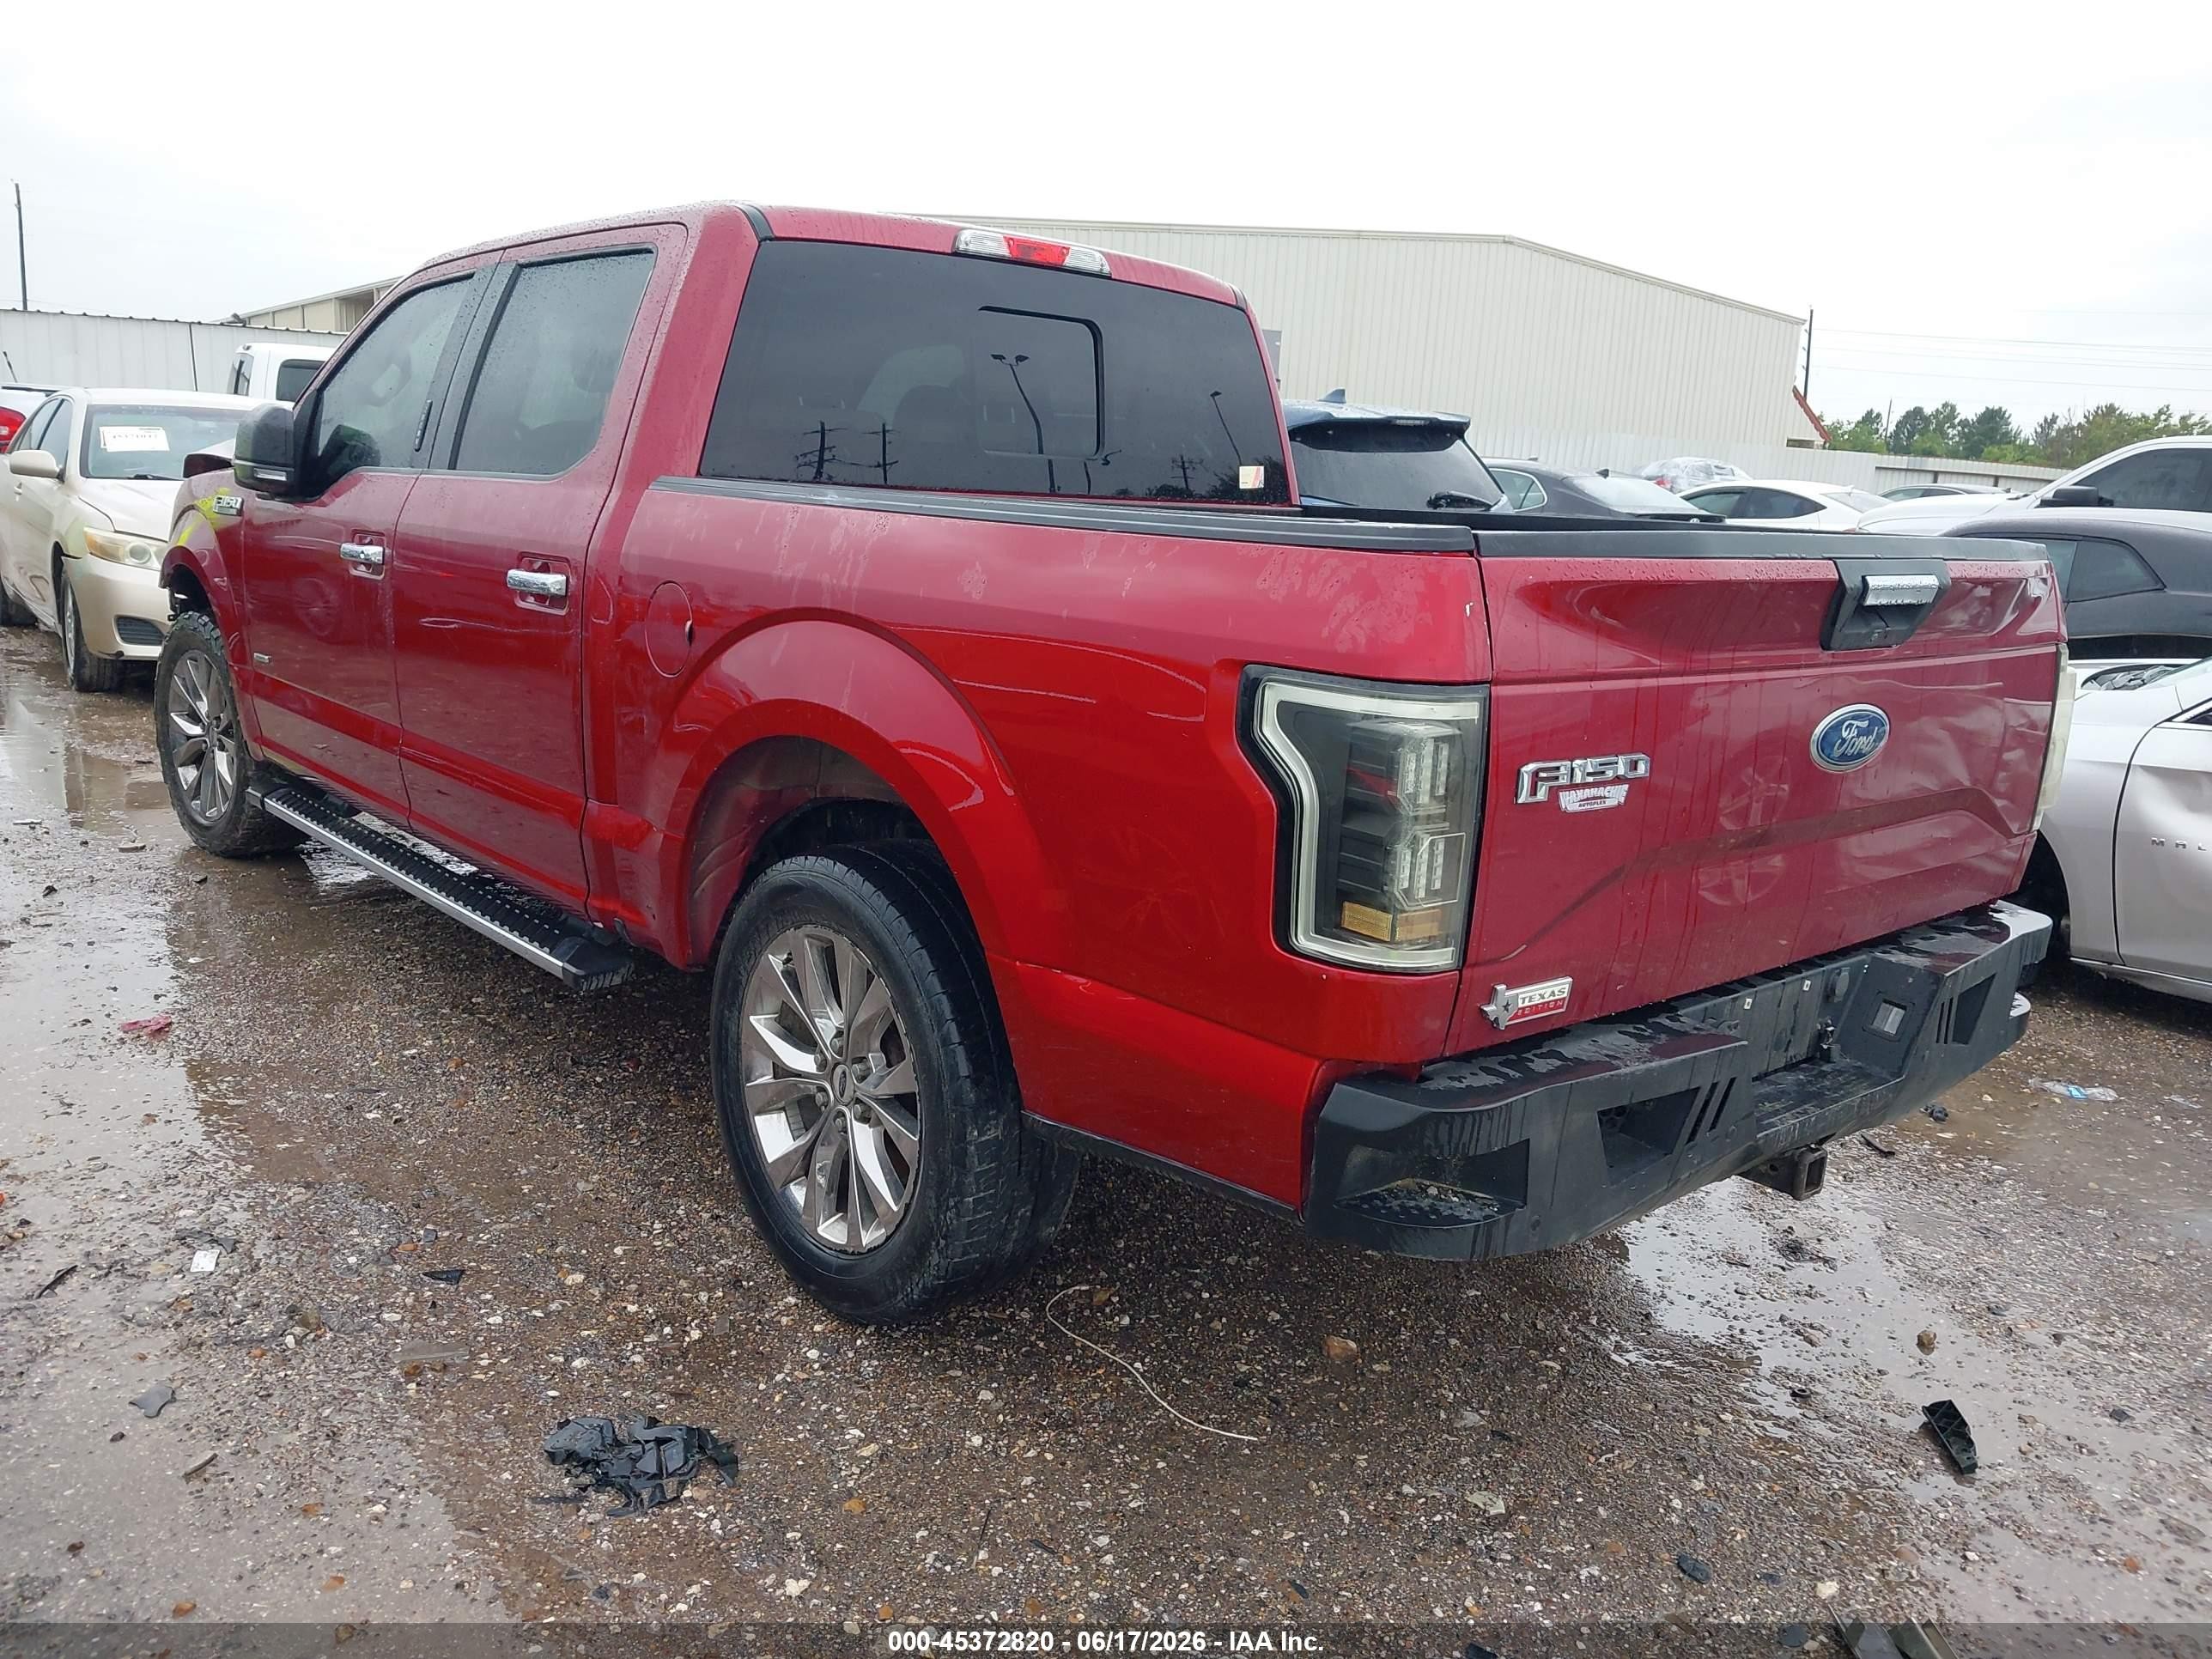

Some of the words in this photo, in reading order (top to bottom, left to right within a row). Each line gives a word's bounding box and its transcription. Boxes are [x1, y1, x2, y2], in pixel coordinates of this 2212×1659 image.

[1832, 720, 1879, 757] Ford
[1578, 799, 1607, 808] AUTOPLEX
[1519, 987, 1566, 1006] TEXAS
[1517, 1000, 1563, 1016] EDITION
